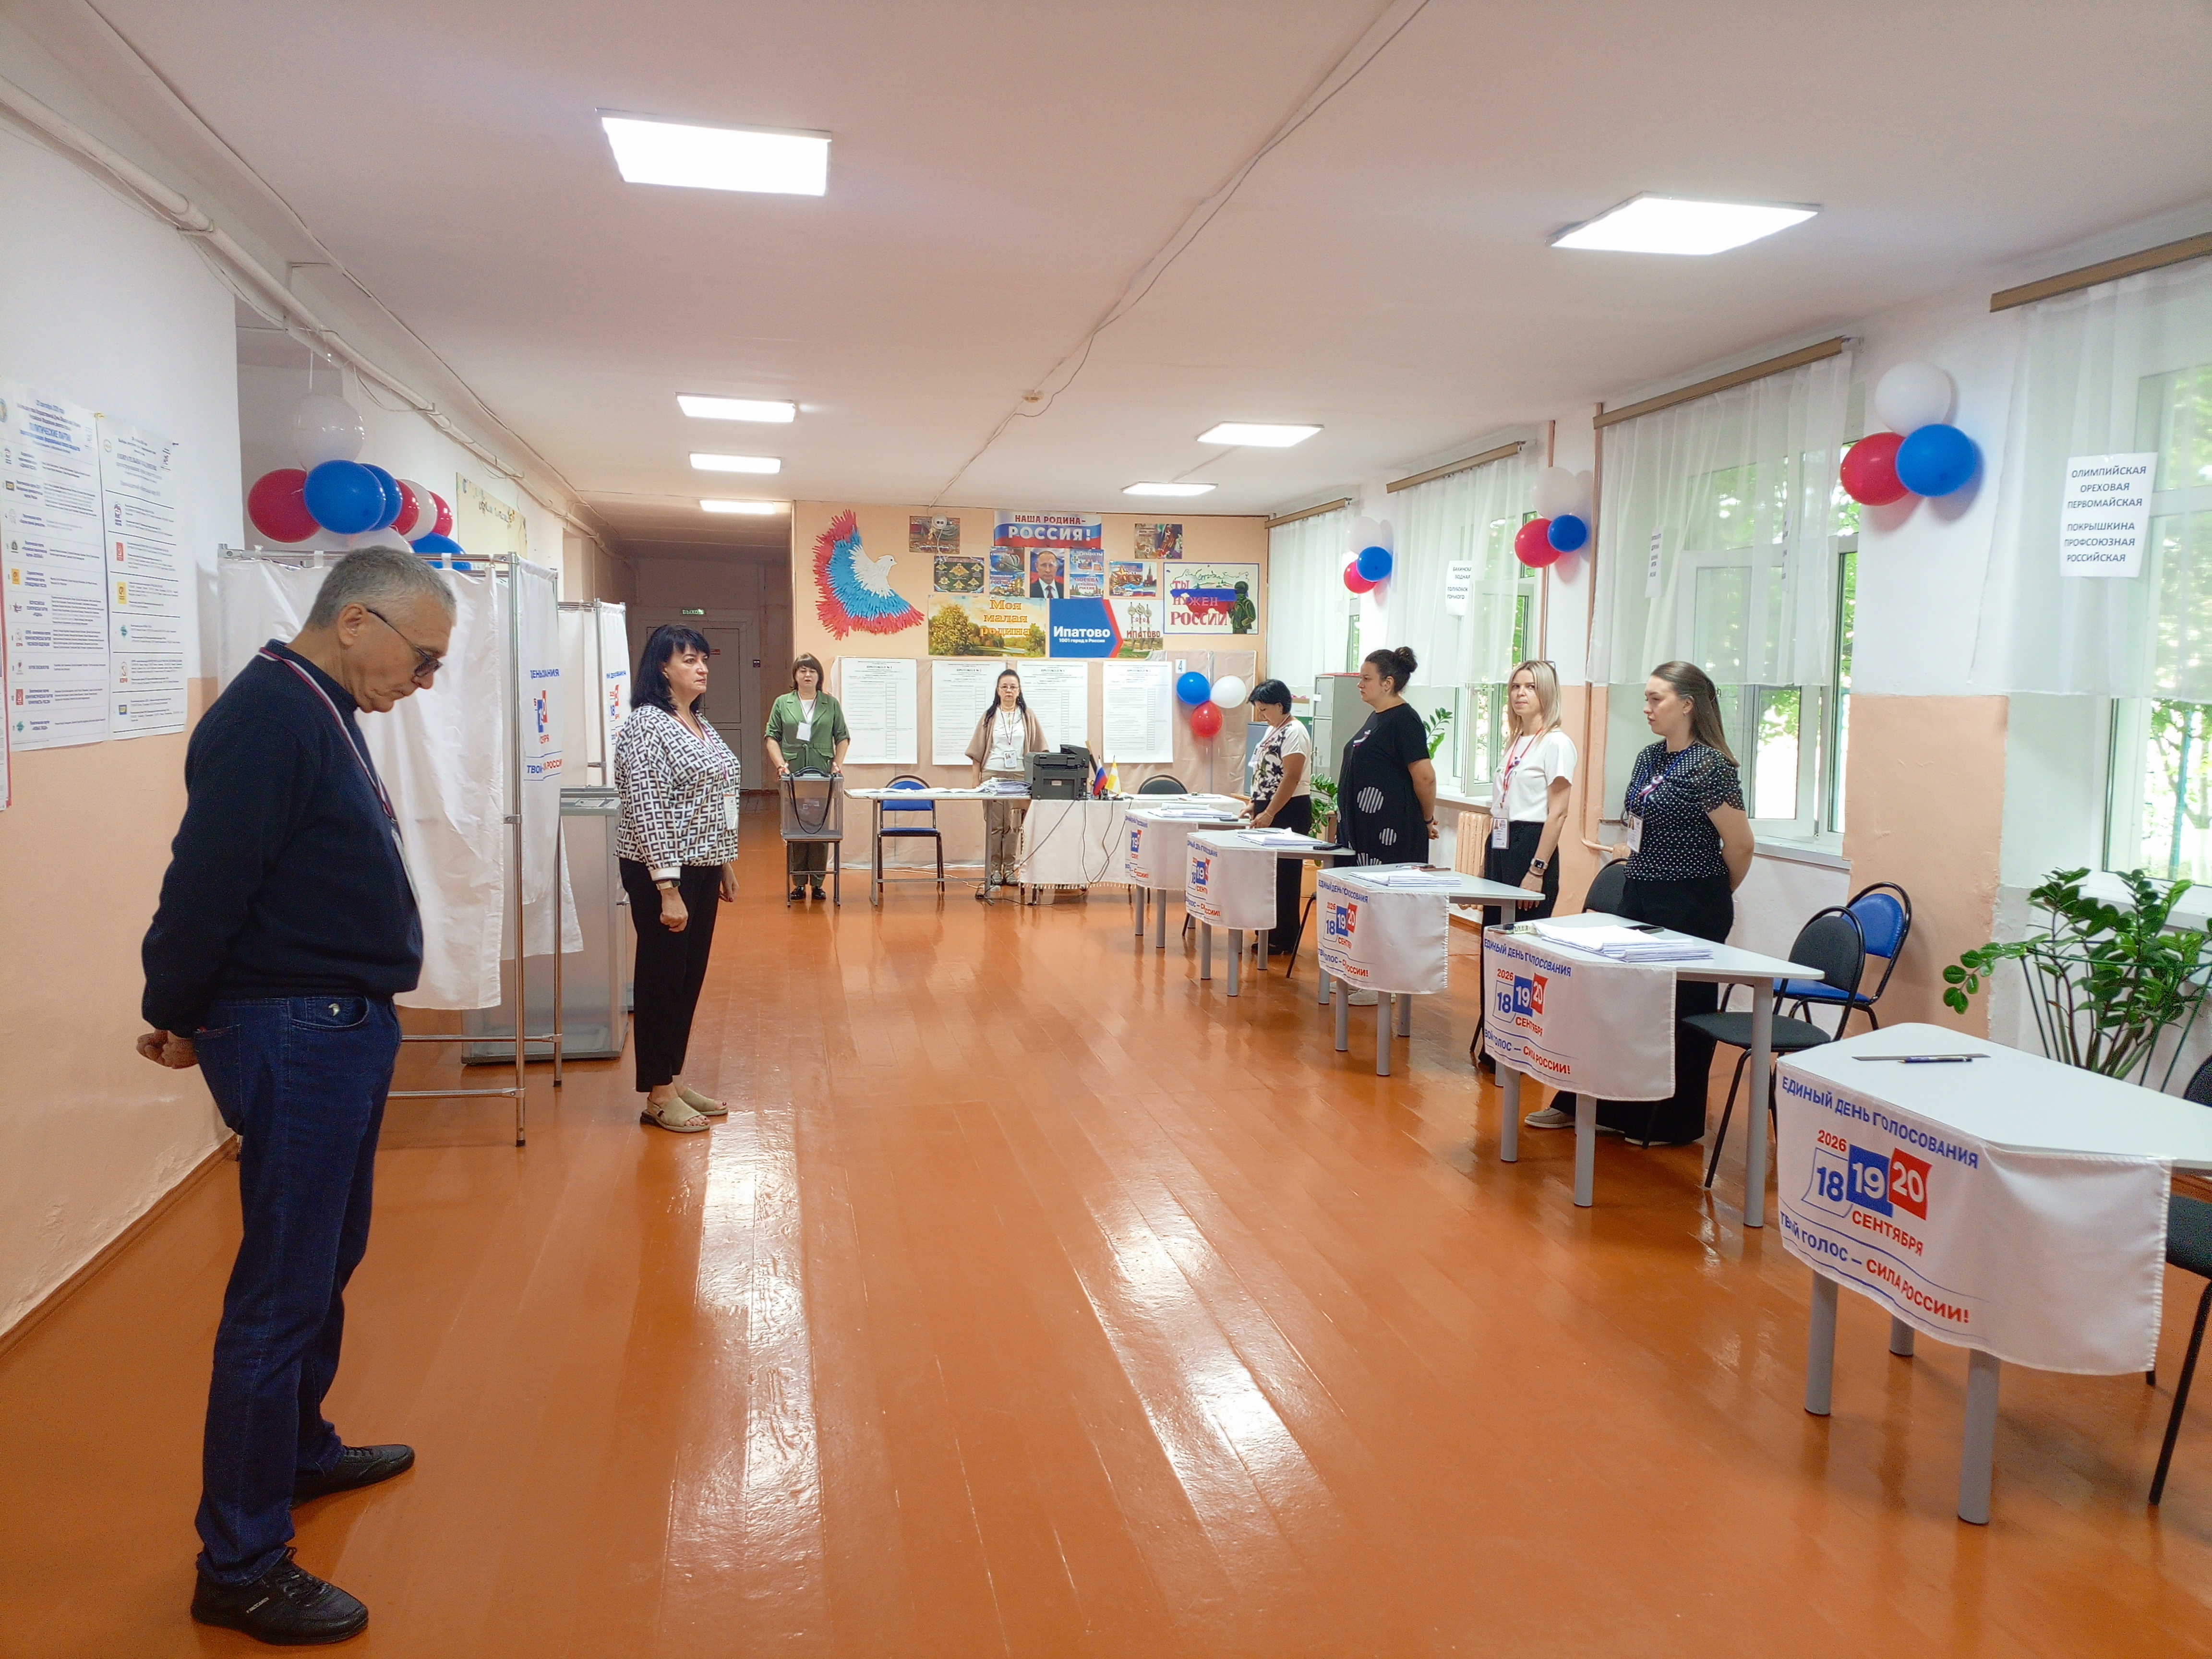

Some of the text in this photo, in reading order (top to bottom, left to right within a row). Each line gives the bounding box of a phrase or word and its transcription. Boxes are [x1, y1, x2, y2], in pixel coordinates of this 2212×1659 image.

[2071, 465, 2147, 478] ОЛИМПИЙСКАЯ
[2080, 482, 2130, 493] ОРЕХОВАЯ
[2067, 497, 2142, 509] ПЕРВОМАЙСКАЯ
[1015, 515, 1041, 523] НАША
[2067, 522, 2135, 531] ПОКРЫШКИНА
[1009, 525, 1091, 541] РОССИЯ!
[2065, 538, 2135, 547] ПРОФСОЮЗНАЯ
[2067, 552, 2126, 562] РОССИЙСКАЯ
[1172, 580, 1190, 589] ТЫ
[990, 600, 1022, 610] Моя
[1172, 597, 1218, 606] НУЖЕН
[984, 614, 1028, 623] малая
[1170, 612, 1227, 626] РОССИИ
[979, 627, 1030, 637] родина
[1054, 625, 1111, 637] Ипатово
[1127, 630, 1160, 638] ИПАТОВО
[1178, 661, 1182, 672] 4
[1197, 867, 1204, 880] 19
[1326, 909, 1355, 935] 18 19 20
[1484, 938, 1506, 954] ЕДИНЫЙ
[1508, 948, 1524, 960] ДЕНЬ
[1497, 968, 1514, 981] 2026
[1497, 981, 1543, 1014] 18 19 20
[1536, 1056, 1571, 1075] РОССИИ!
[1782, 1076, 1979, 1169] ЕДИНЫЙ ДЕНЬ ГОЛОСОВАНИЯ
[1816, 1129, 1847, 1152] 2026
[1816, 1161, 1925, 1203] 18 19 20
[1852, 1210, 1924, 1256] СЕНТЯБРЯ
[1801, 1230, 1848, 1262] ГОЛОС
[1866, 1258, 1901, 1288] СИЛА
[1901, 1281, 1970, 1323] РОССИИ!
